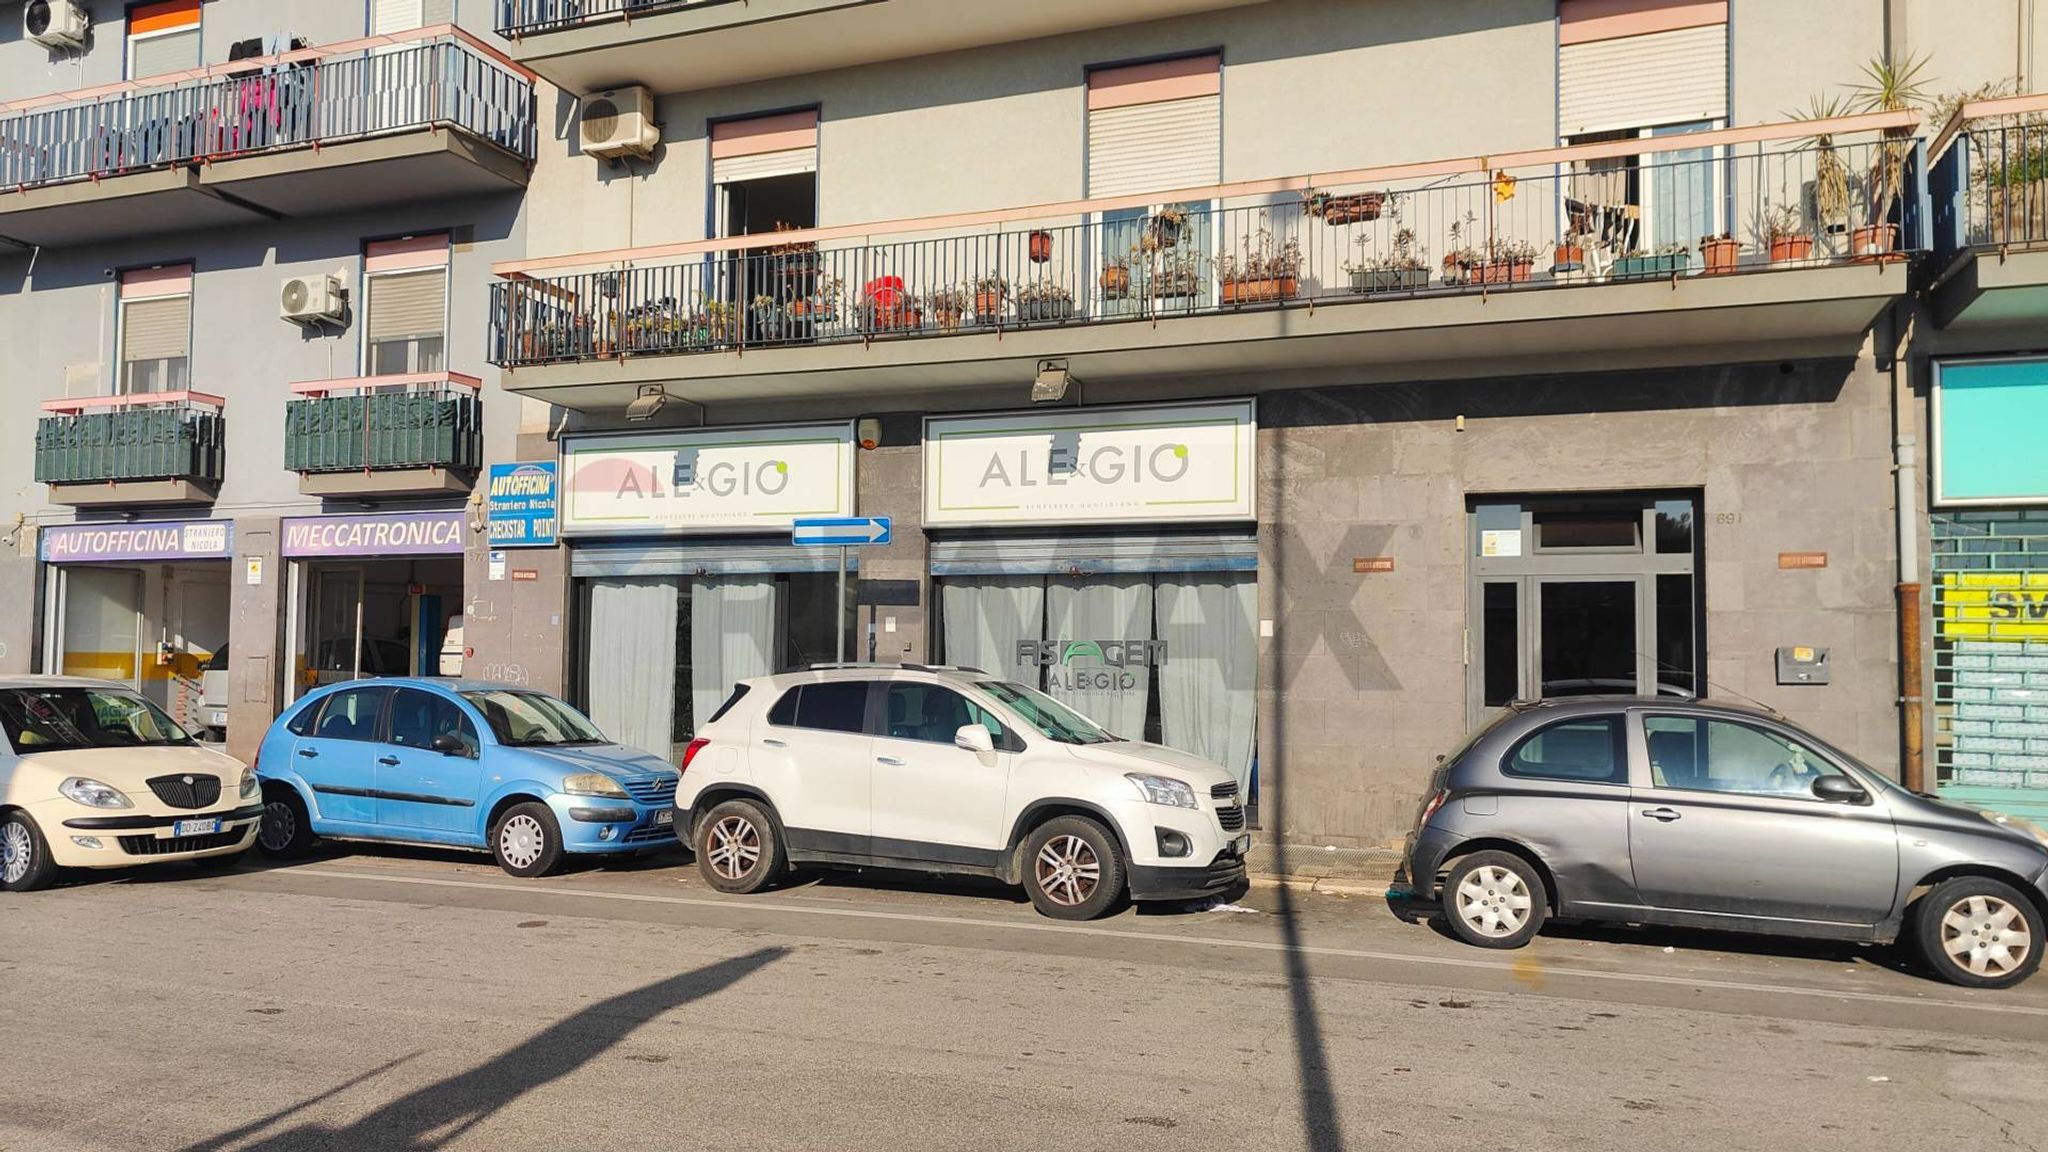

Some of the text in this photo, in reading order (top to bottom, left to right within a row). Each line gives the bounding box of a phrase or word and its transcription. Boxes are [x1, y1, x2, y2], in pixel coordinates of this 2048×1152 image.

[490, 474, 550, 496] AUTOFFICINA
[489, 498, 555, 511] Straniero Nicola
[184, 527, 225, 538] STRANIERO
[287, 520, 462, 548] MECCATRONICA
[489, 518, 555, 539] CHECKSTAR POINT
[56, 529, 179, 554] AUTOFFICINA
[190, 540, 219, 551] NICOLA
